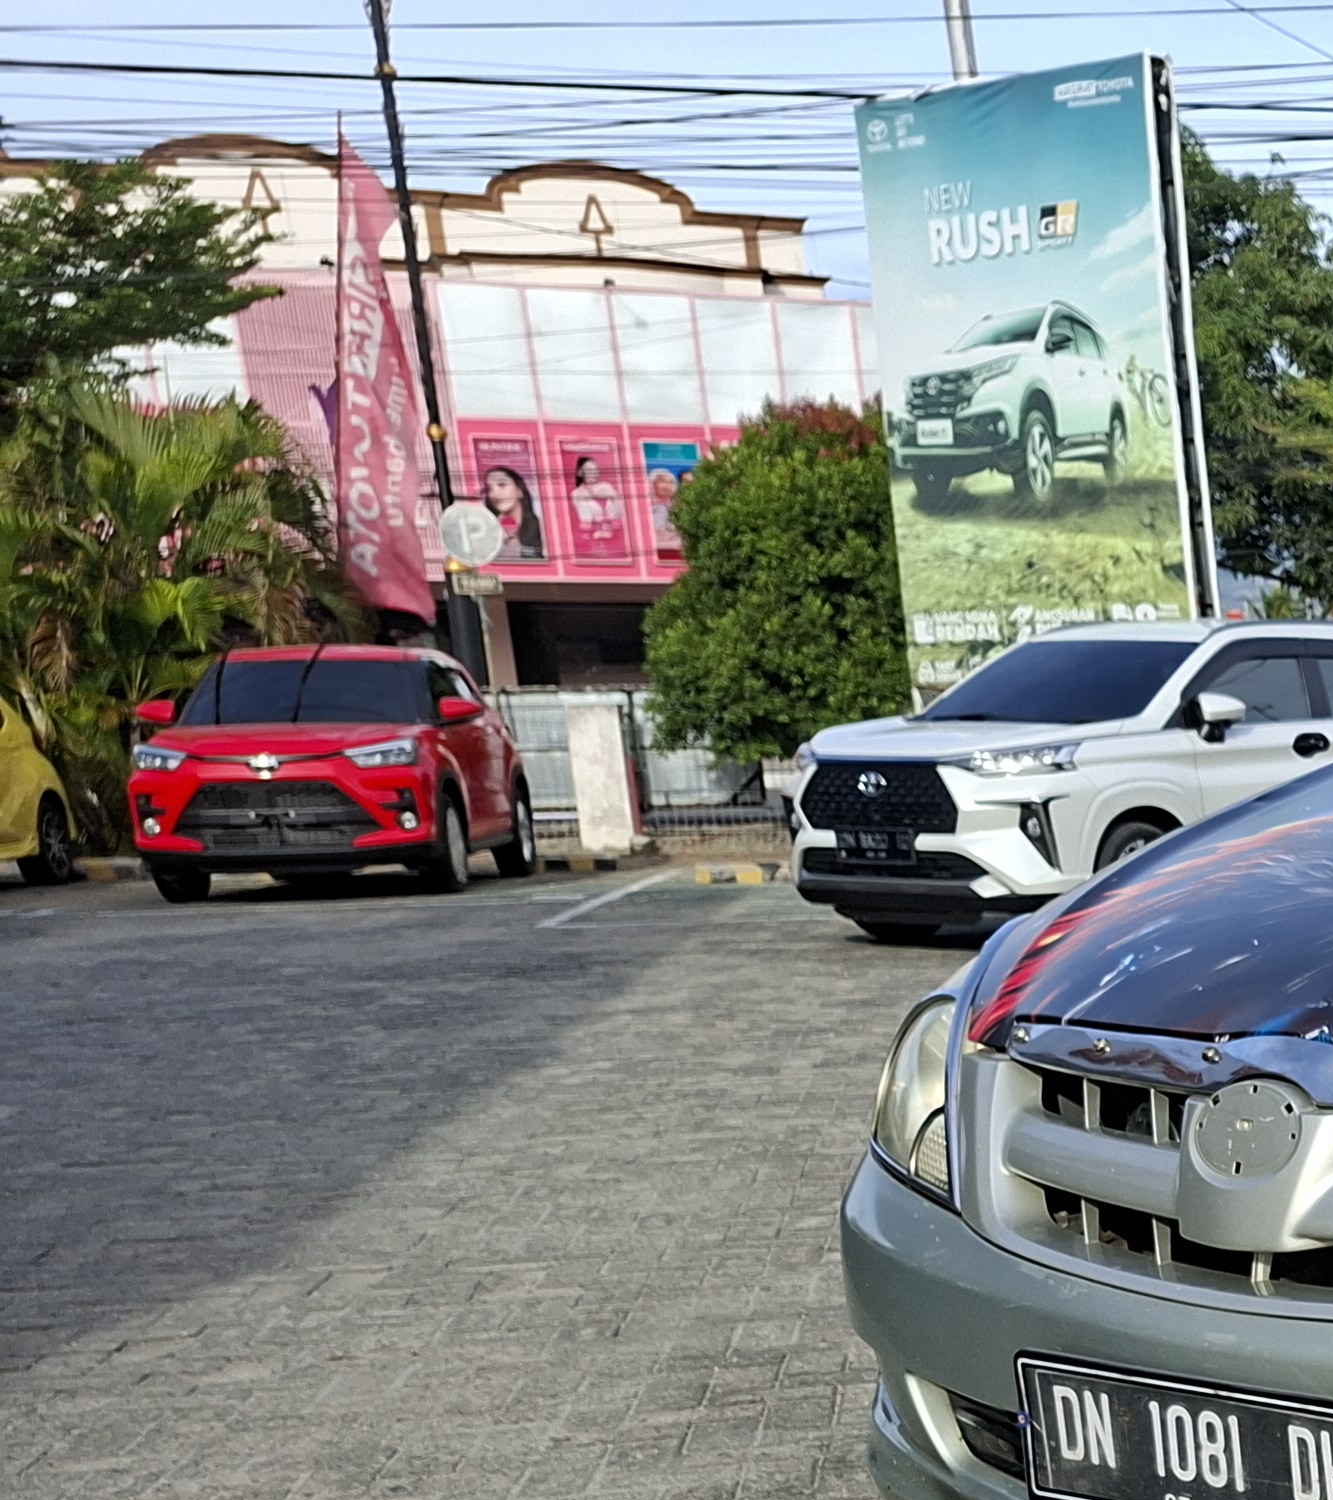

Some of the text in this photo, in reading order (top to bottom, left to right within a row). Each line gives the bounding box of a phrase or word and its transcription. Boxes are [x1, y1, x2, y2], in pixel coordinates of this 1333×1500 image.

[923, 180, 972, 213] NEW
[929, 204, 1032, 264] RUSH
[1053, 1385, 1116, 1469] DN
[1149, 1400, 1245, 1492] 1081
